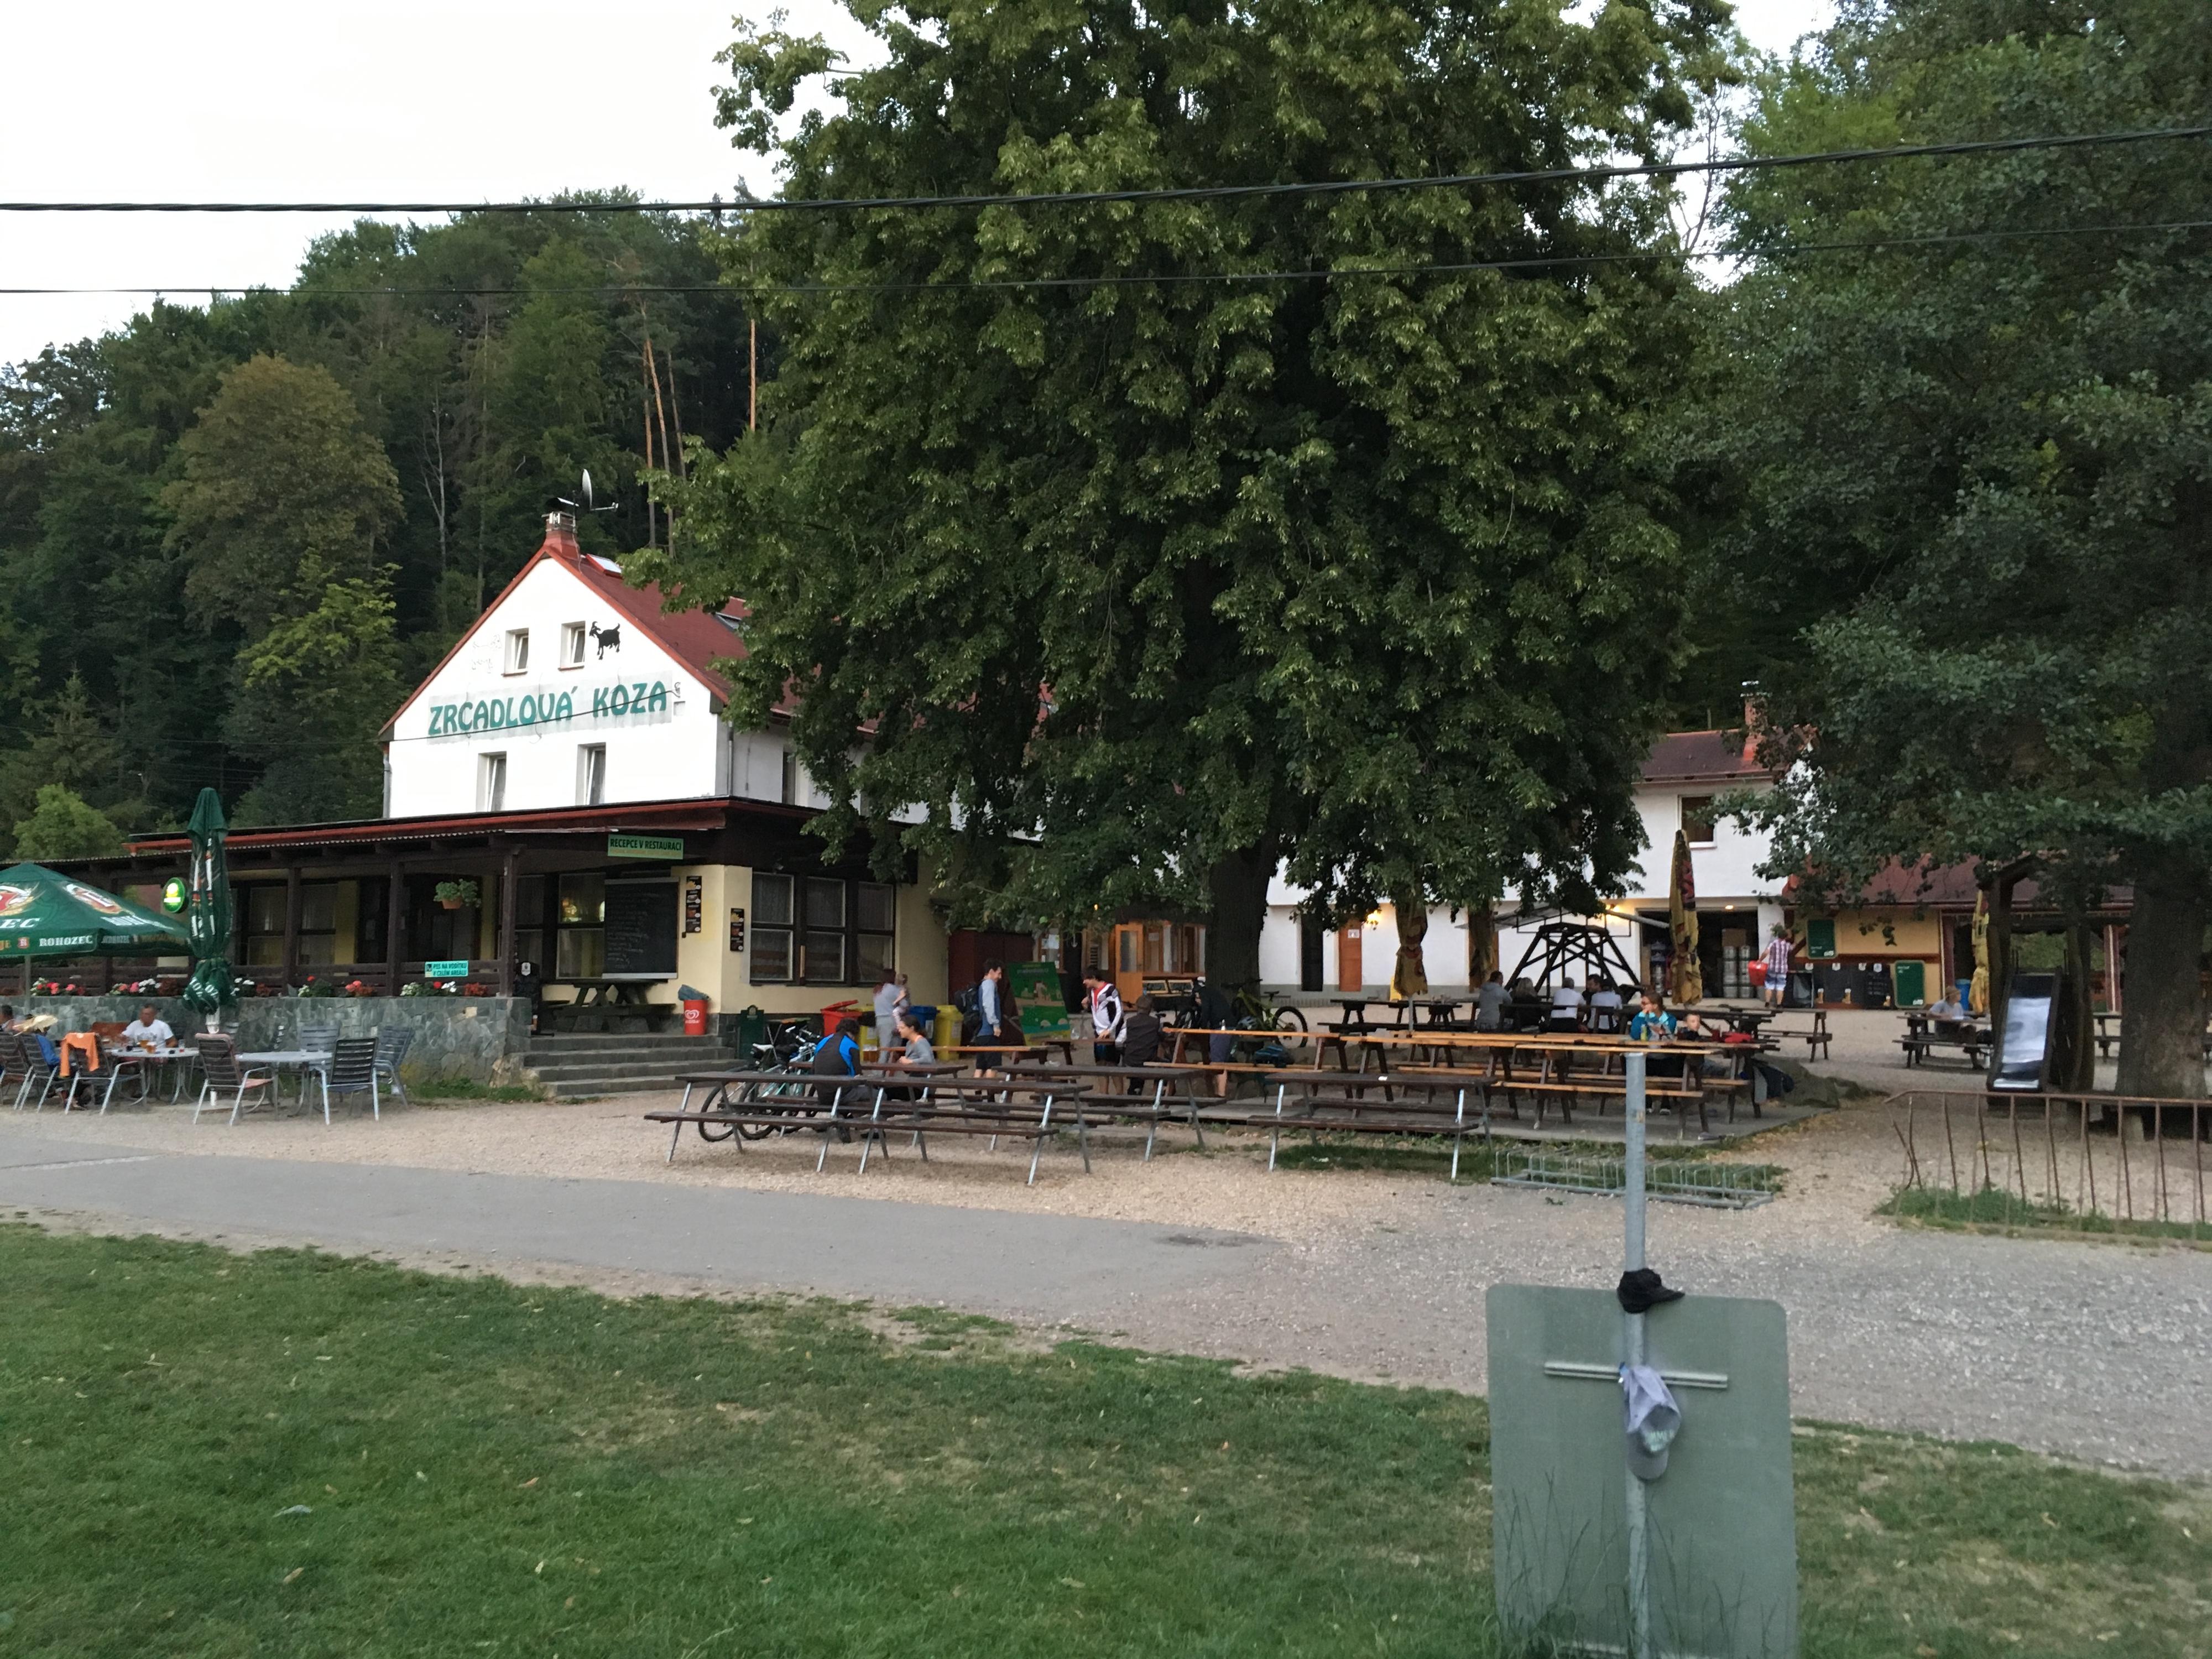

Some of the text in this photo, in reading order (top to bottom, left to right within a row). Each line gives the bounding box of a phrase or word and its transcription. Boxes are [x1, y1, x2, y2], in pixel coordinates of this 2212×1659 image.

[429, 681, 667, 735] ZRCADLOVÁ KOZA
[610, 838, 638, 848] RECEPCE
[645, 841, 681, 851] RESTAURACI
[39, 935, 93, 947] ROHOZEC
